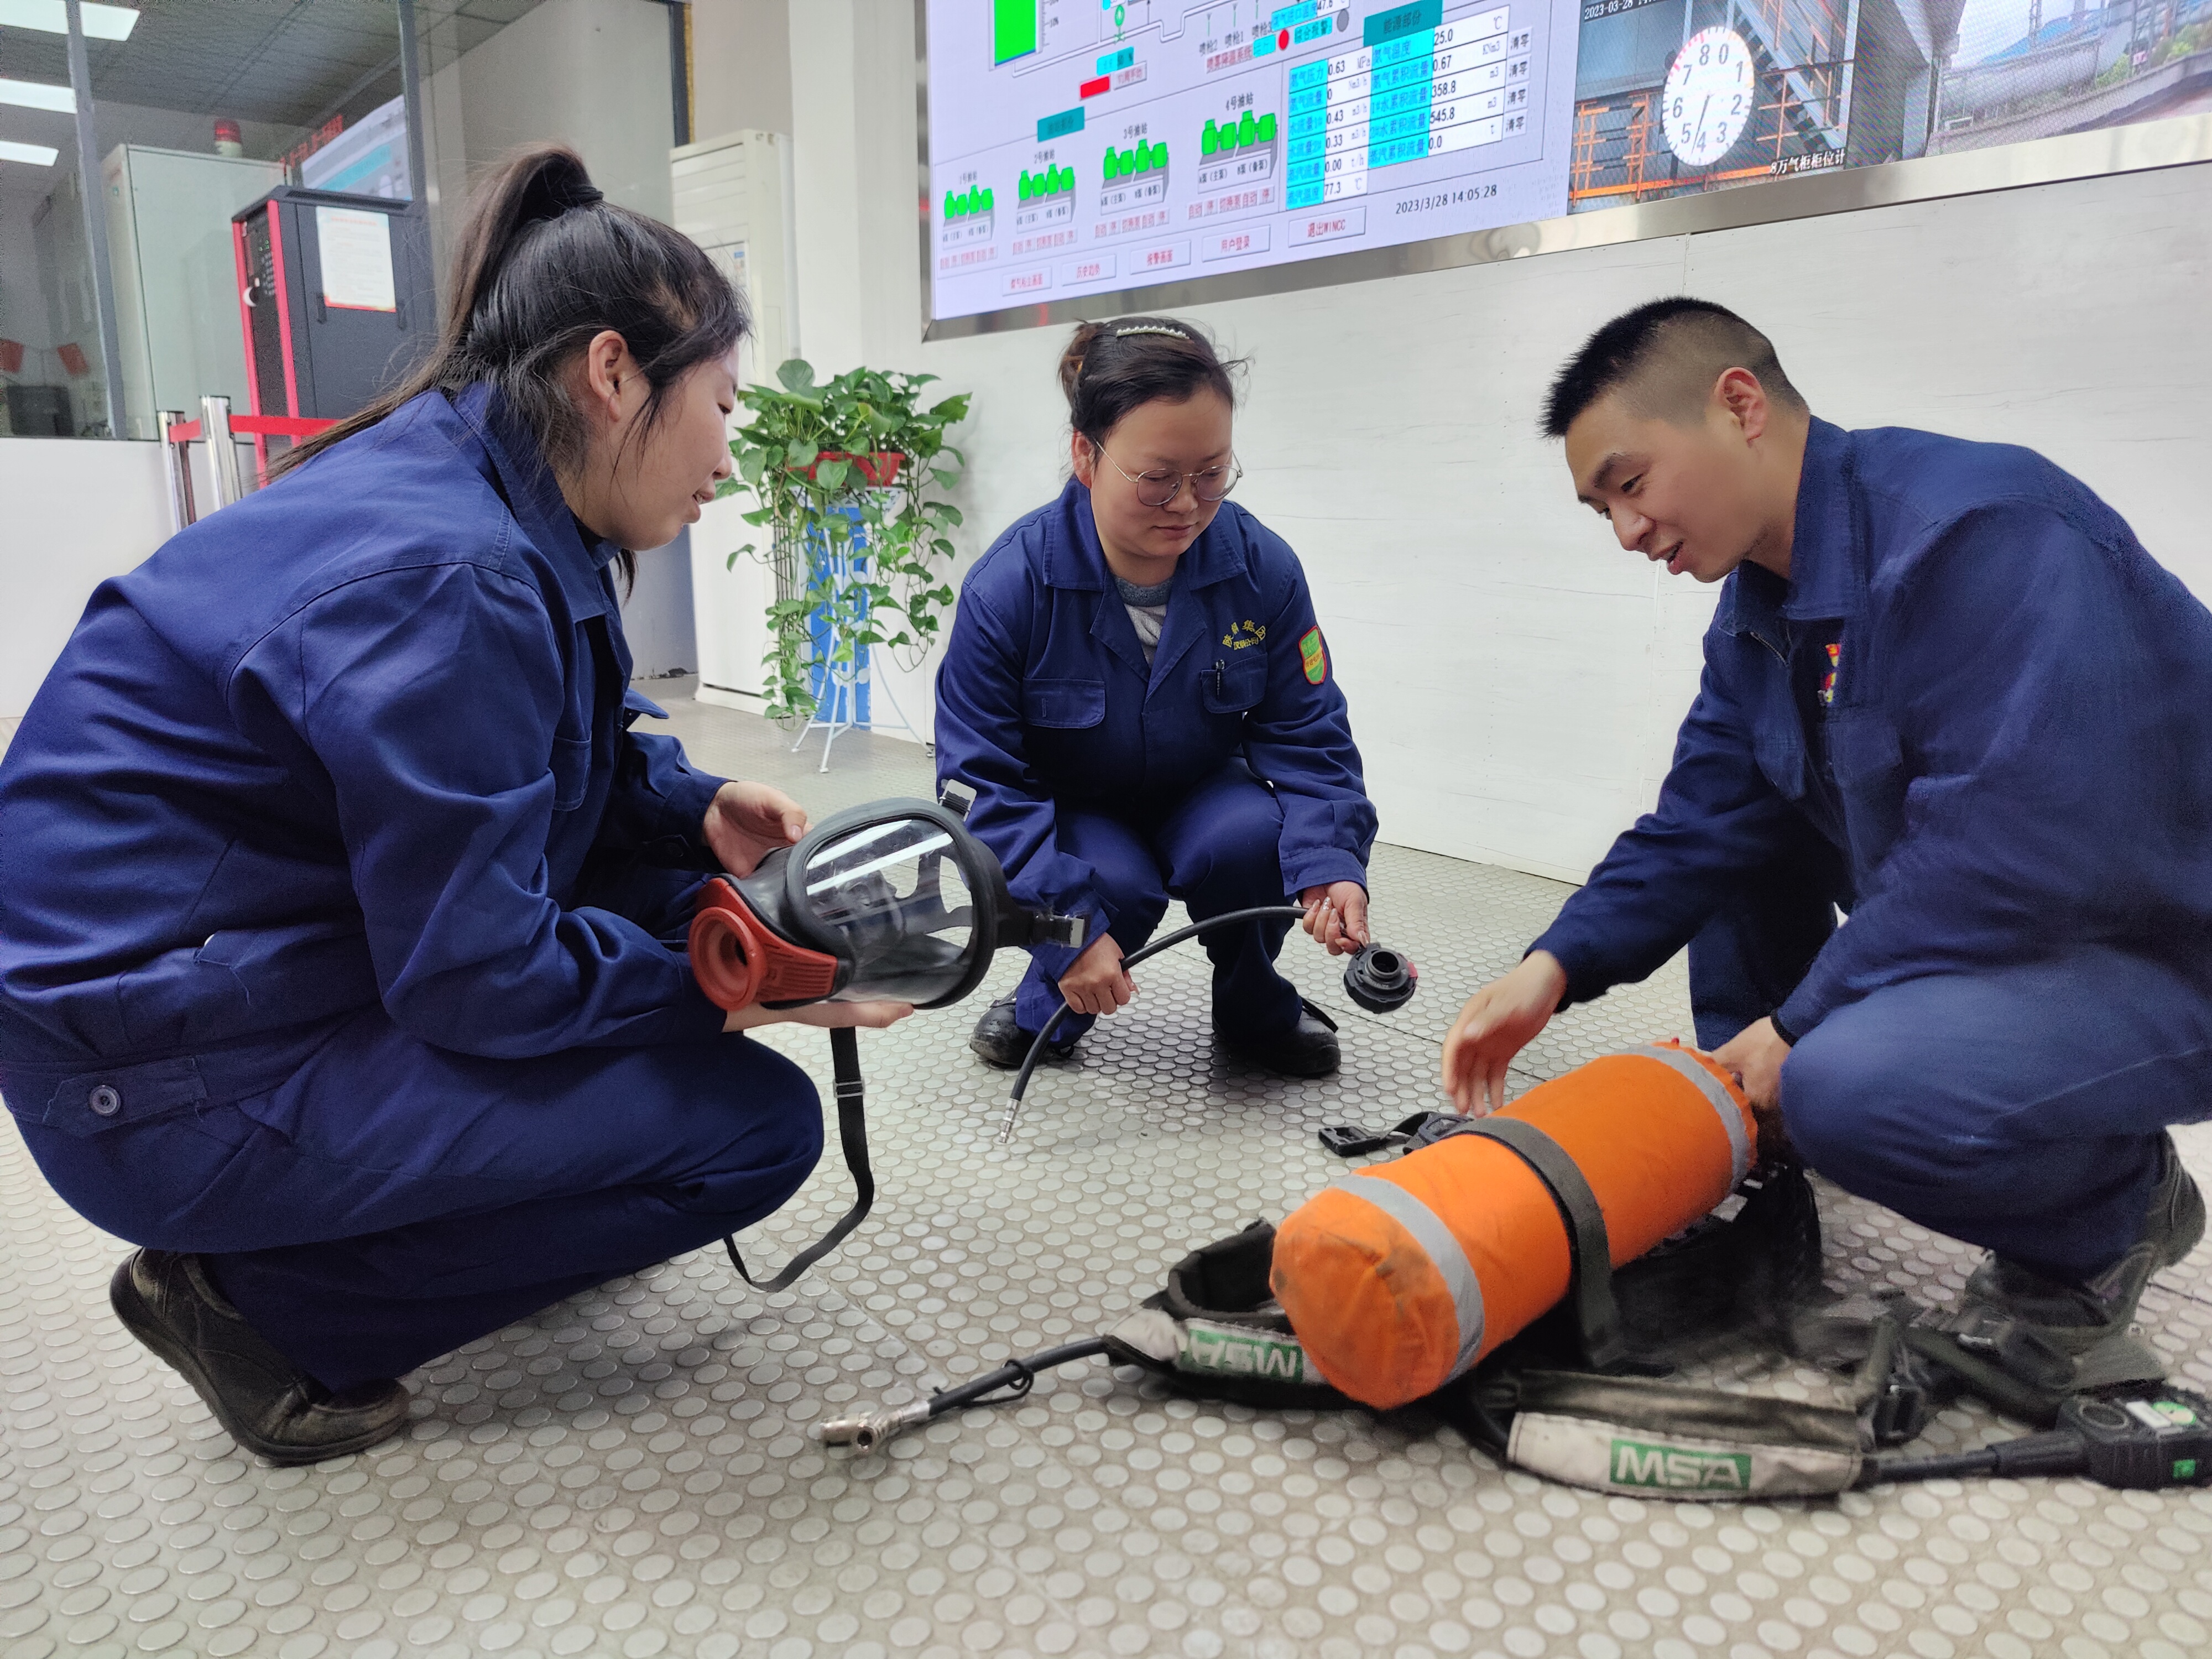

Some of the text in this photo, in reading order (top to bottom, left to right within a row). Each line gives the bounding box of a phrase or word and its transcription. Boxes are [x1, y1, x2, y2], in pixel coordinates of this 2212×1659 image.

[1434, 29, 1453, 46] 25.0
[1510, 33, 1529, 50] 清零
[1433, 55, 1452, 71] 0.67
[1699, 44, 1710, 66] 8
[1719, 44, 1729, 65] 0
[1328, 60, 1345, 75] 0.63
[1509, 61, 1527, 77] 清零
[1682, 64, 1692, 86] 7
[1736, 61, 1743, 82] 1
[1432, 80, 1456, 98] 358.8
[1507, 88, 1526, 105] 清零
[1673, 96, 1683, 118] 6
[1731, 94, 1743, 116] 2
[1327, 109, 1344, 125] 0.43
[1430, 107, 1455, 124] 545.8
[1506, 116, 1525, 132] 清零
[1681, 123, 1691, 144] 5
[1717, 122, 1728, 143] 3
[1326, 134, 1343, 149] 0.33
[1428, 135, 1442, 149] 0.0
[1697, 132, 1707, 152] 4
[1325, 158, 1342, 173] 0.00
[1324, 181, 1341, 196] 77.3
[1396, 184, 1497, 214] 2023/3/28 14:05:28
[1616, 1446, 1744, 1488] MSA
